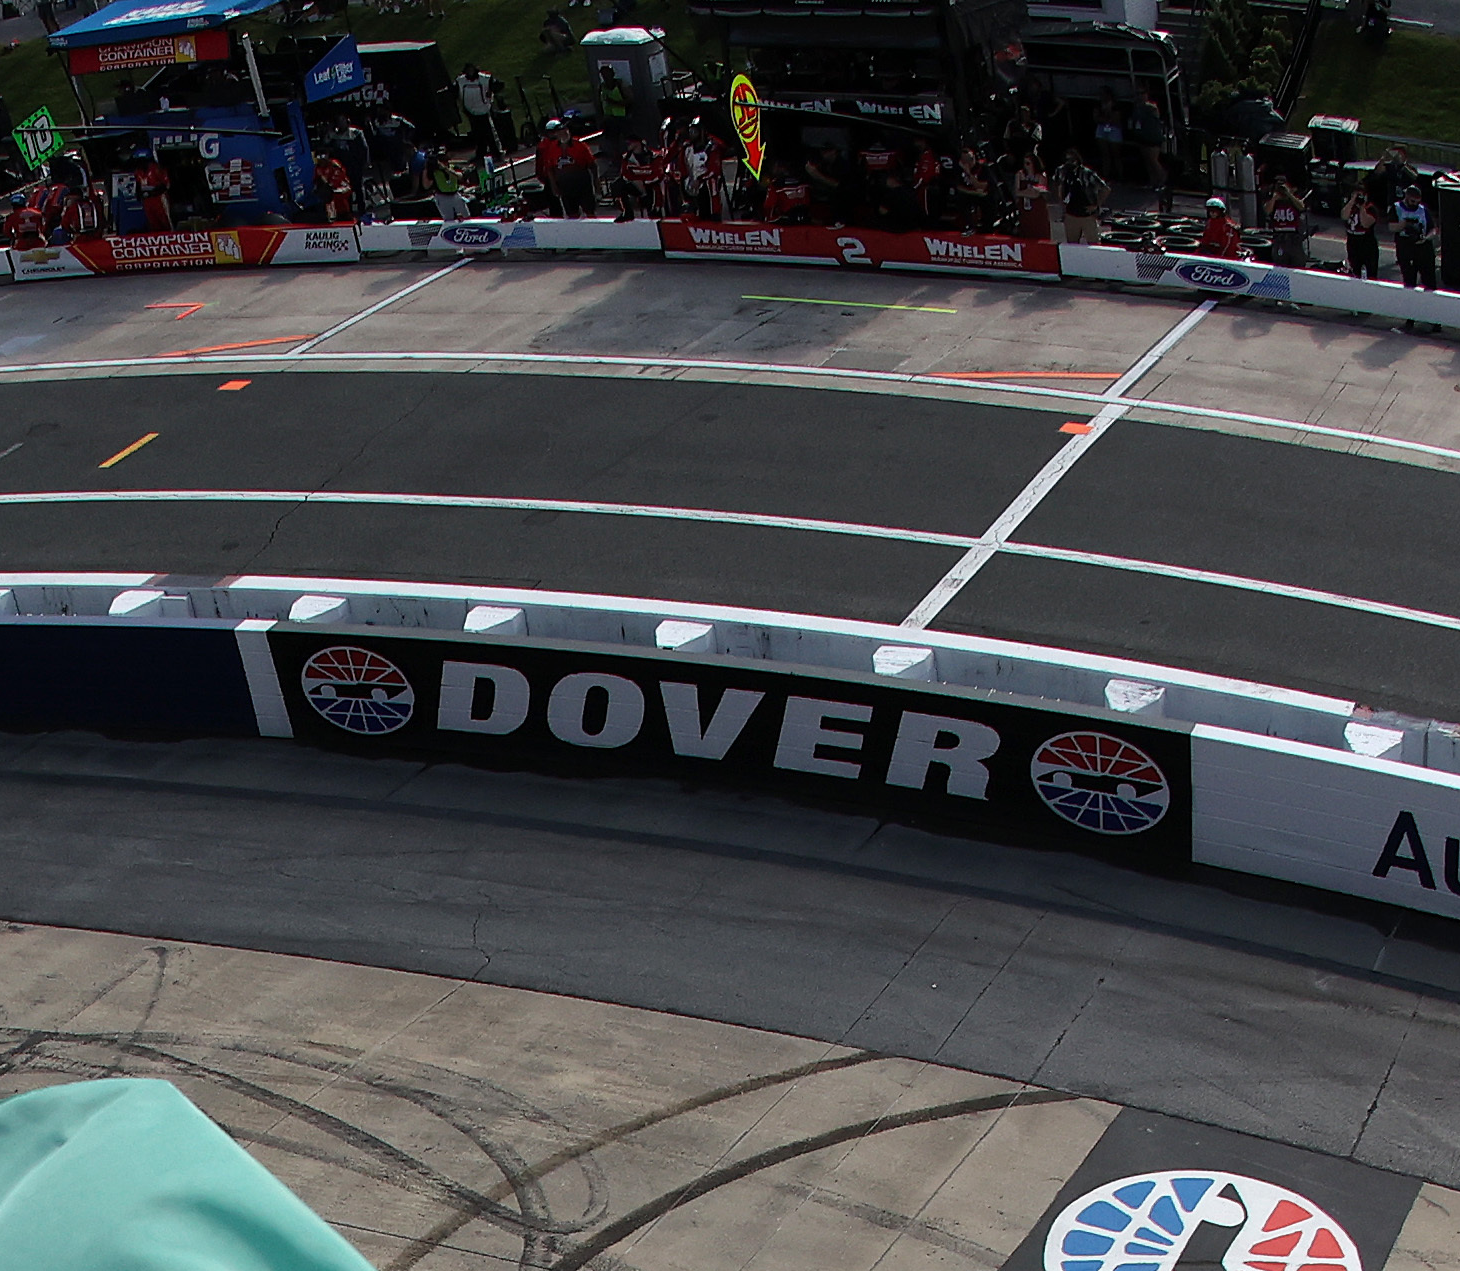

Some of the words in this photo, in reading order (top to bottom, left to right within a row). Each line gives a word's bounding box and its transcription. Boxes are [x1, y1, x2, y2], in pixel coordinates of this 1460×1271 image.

[98, 47, 175, 63] CONTAINER
[107, 231, 209, 249] CHAMPION
[304, 240, 338, 251] RACING
[305, 231, 340, 242] KAULIG
[446, 226, 490, 246] Ford
[689, 226, 782, 247] WHELEN
[111, 243, 213, 261] CONTAINER
[837, 237, 873, 265] 2
[923, 237, 1023, 262] WHELEN
[116, 259, 215, 271] CORPORATION
[1187, 265, 1235, 287] Ford
[436, 660, 1001, 801] DOVER
